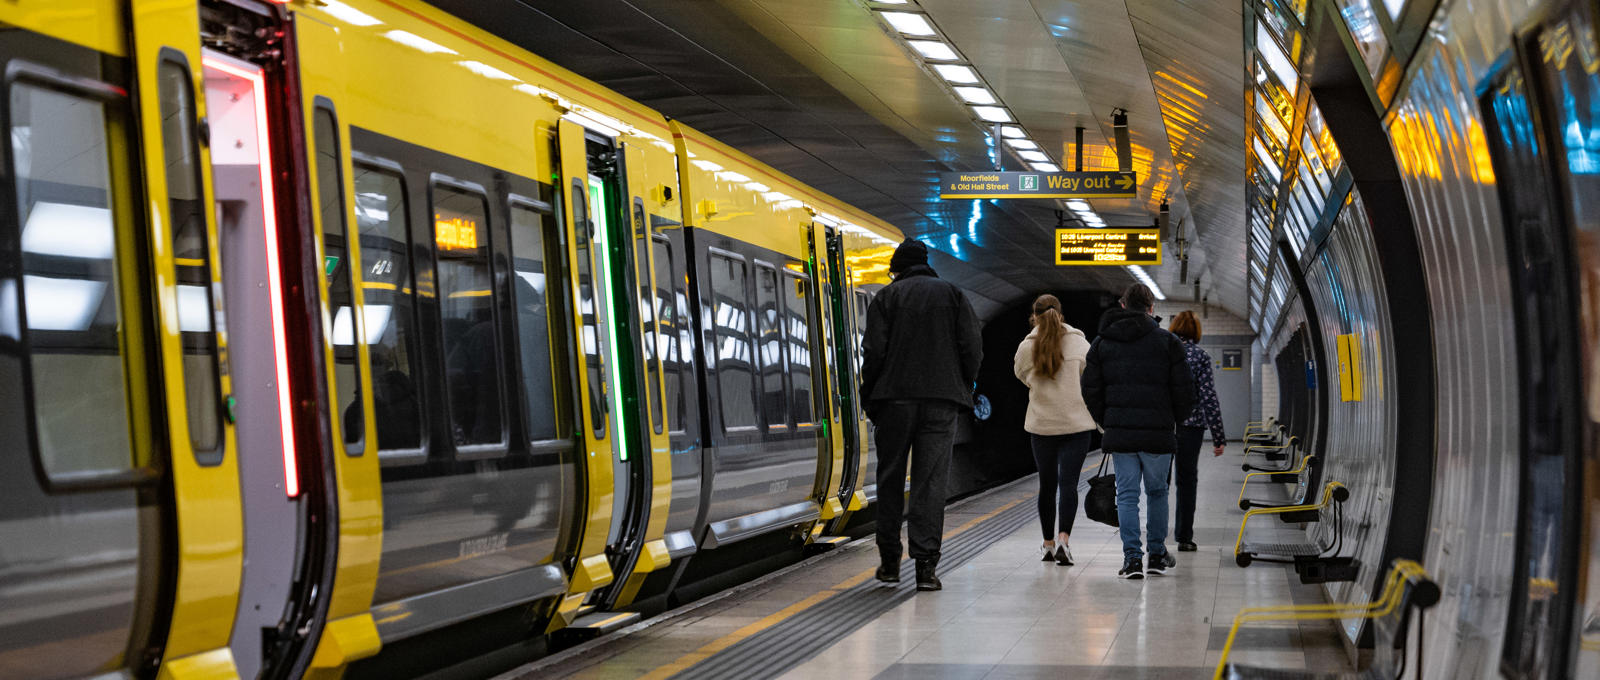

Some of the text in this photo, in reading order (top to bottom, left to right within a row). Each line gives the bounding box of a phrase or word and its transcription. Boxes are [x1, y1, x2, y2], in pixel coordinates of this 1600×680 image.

[1047, 175, 1111, 191] Way out
[1077, 233, 1104, 241] Liverpool
[1229, 355, 1235, 367] 1
